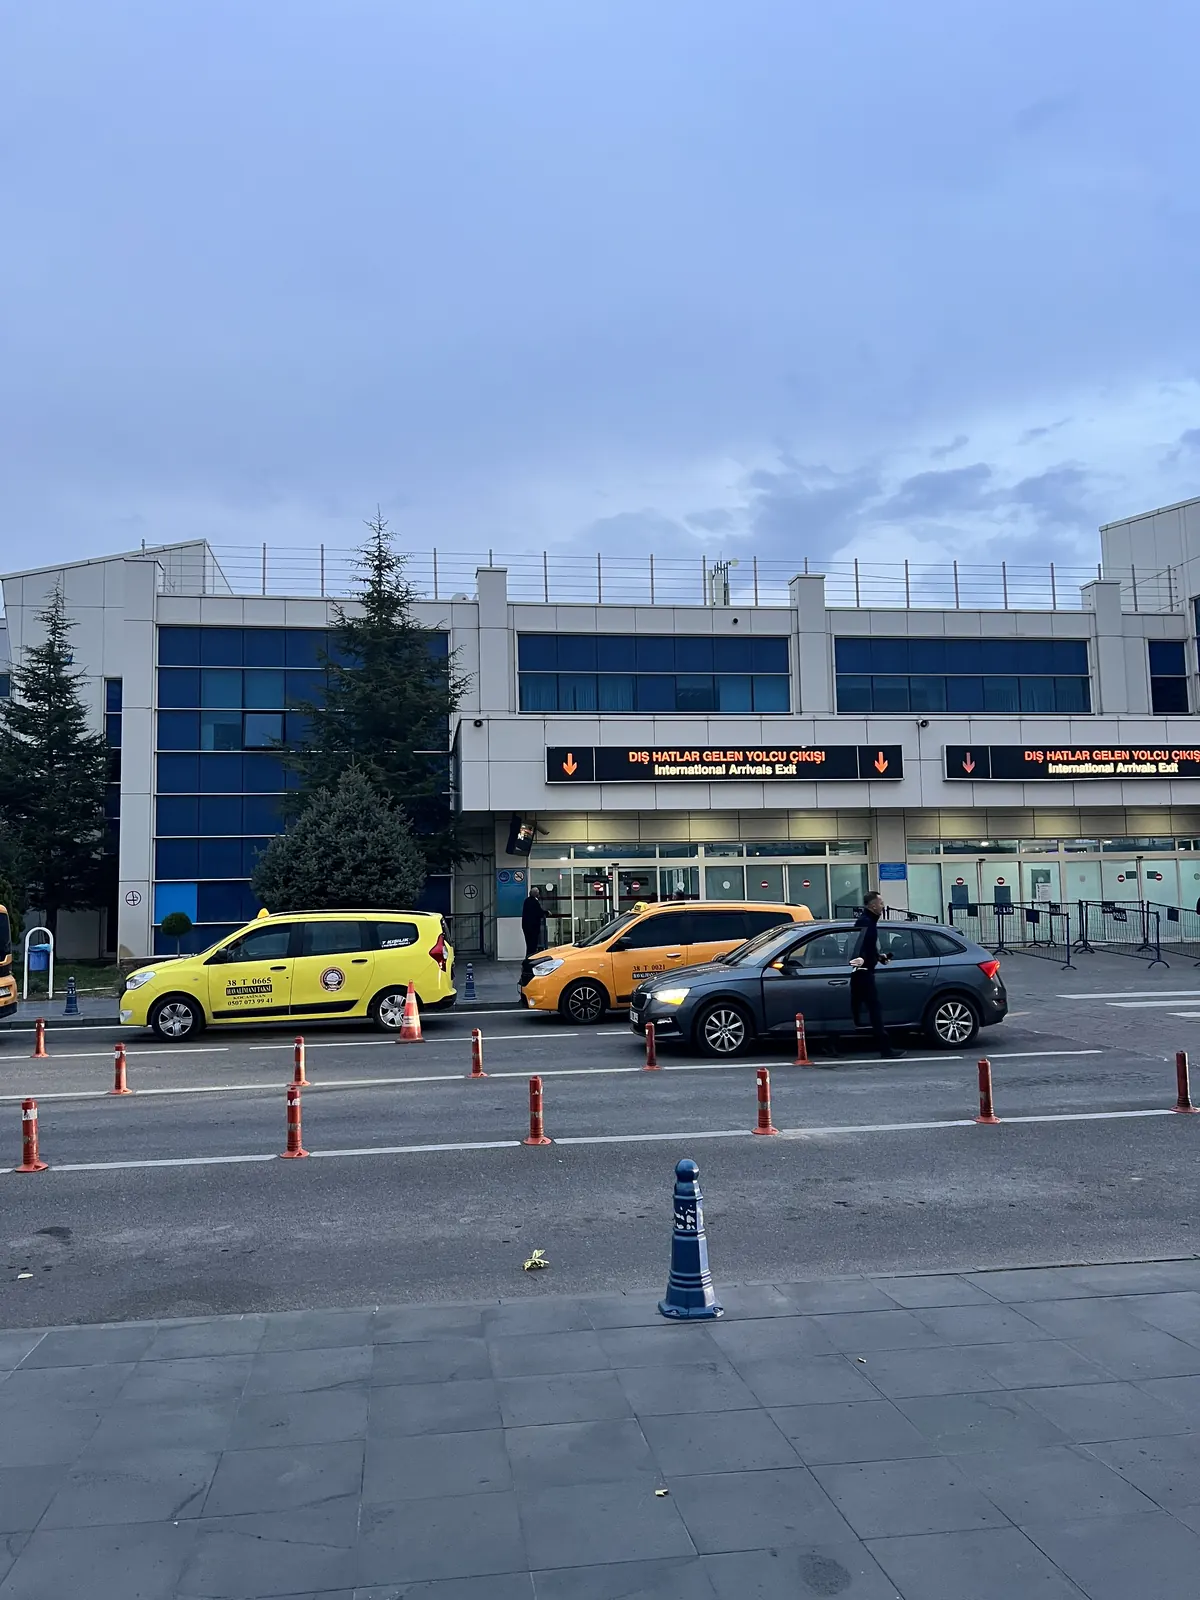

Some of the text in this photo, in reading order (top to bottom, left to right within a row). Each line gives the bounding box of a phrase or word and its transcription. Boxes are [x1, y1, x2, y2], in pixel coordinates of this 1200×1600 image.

[628, 750, 826, 765] DIŞ HATLAR GELEN YOLCU ÇIKIŞI
[1024, 751, 1045, 764] DIŞ
[1046, 751, 1090, 761] HATLAR
[1092, 751, 1130, 761] GELEN
[1131, 750, 1169, 761] YOLCU
[654, 763, 797, 776] International Arrivals Exit
[1048, 763, 1179, 773] International Arrivals Exit
[240, 978, 248, 986] T
[252, 976, 272, 985] 0665
